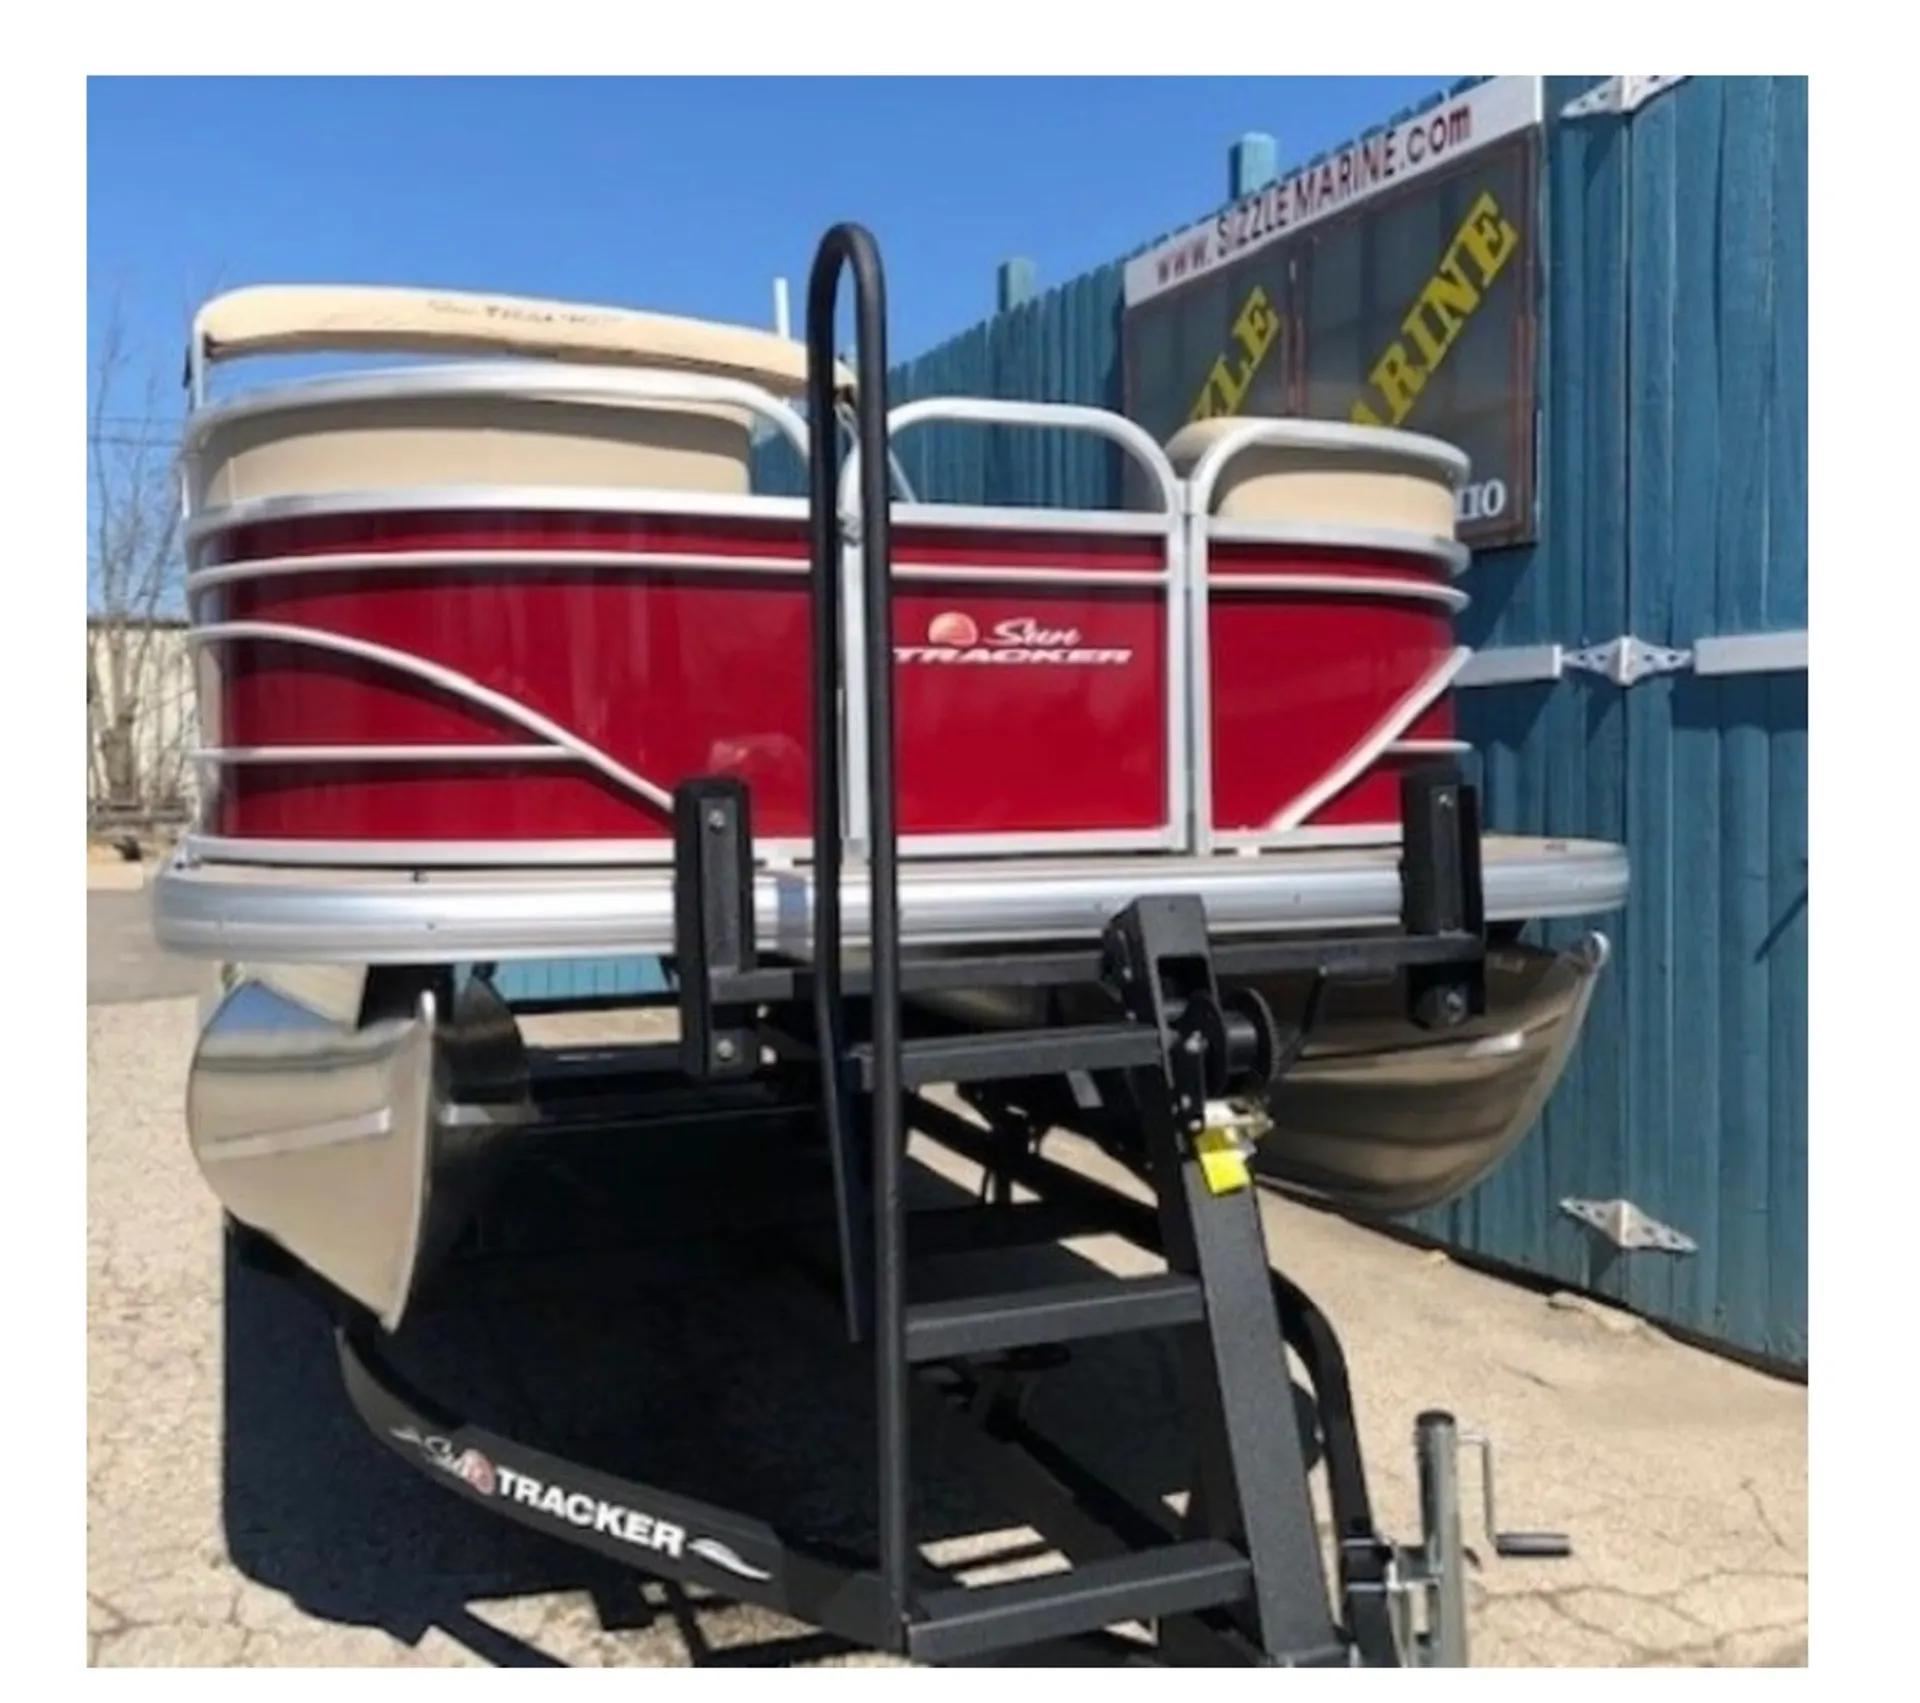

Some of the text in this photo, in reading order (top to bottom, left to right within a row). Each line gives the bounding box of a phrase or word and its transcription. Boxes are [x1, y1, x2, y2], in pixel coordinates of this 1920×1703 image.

[984, 617, 1081, 647] Sun
[892, 646, 1133, 665] TRACKER
[496, 1464, 687, 1559] TRACKER
